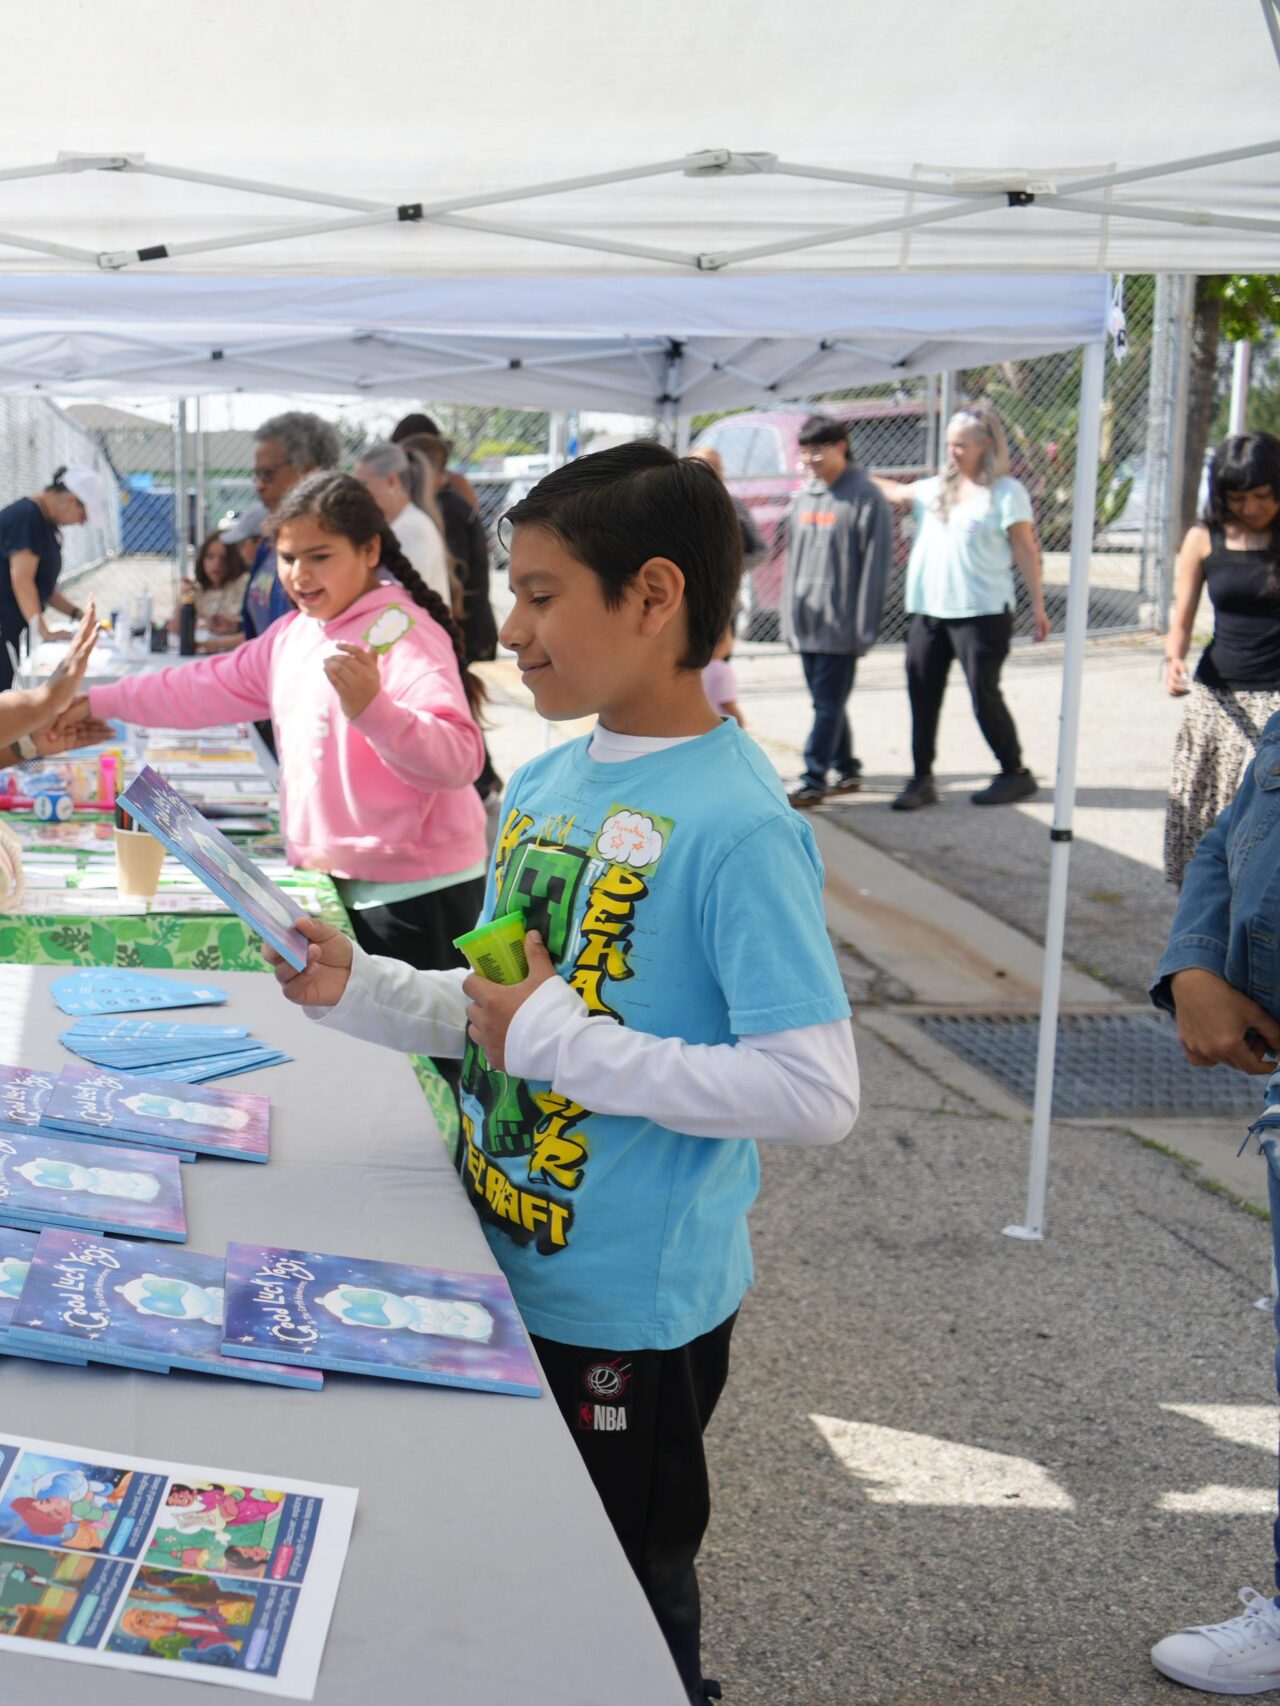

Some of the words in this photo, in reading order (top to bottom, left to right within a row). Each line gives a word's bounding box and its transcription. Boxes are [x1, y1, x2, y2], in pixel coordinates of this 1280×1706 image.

[61, 1245, 120, 1269] Yogi
[255, 1258, 316, 1281] Yogi
[51, 1264, 88, 1291] Luck
[250, 1279, 285, 1305] Luck
[59, 1293, 109, 1329] Good
[262, 1307, 318, 1341] Good
[593, 1404, 628, 1431] NBA
